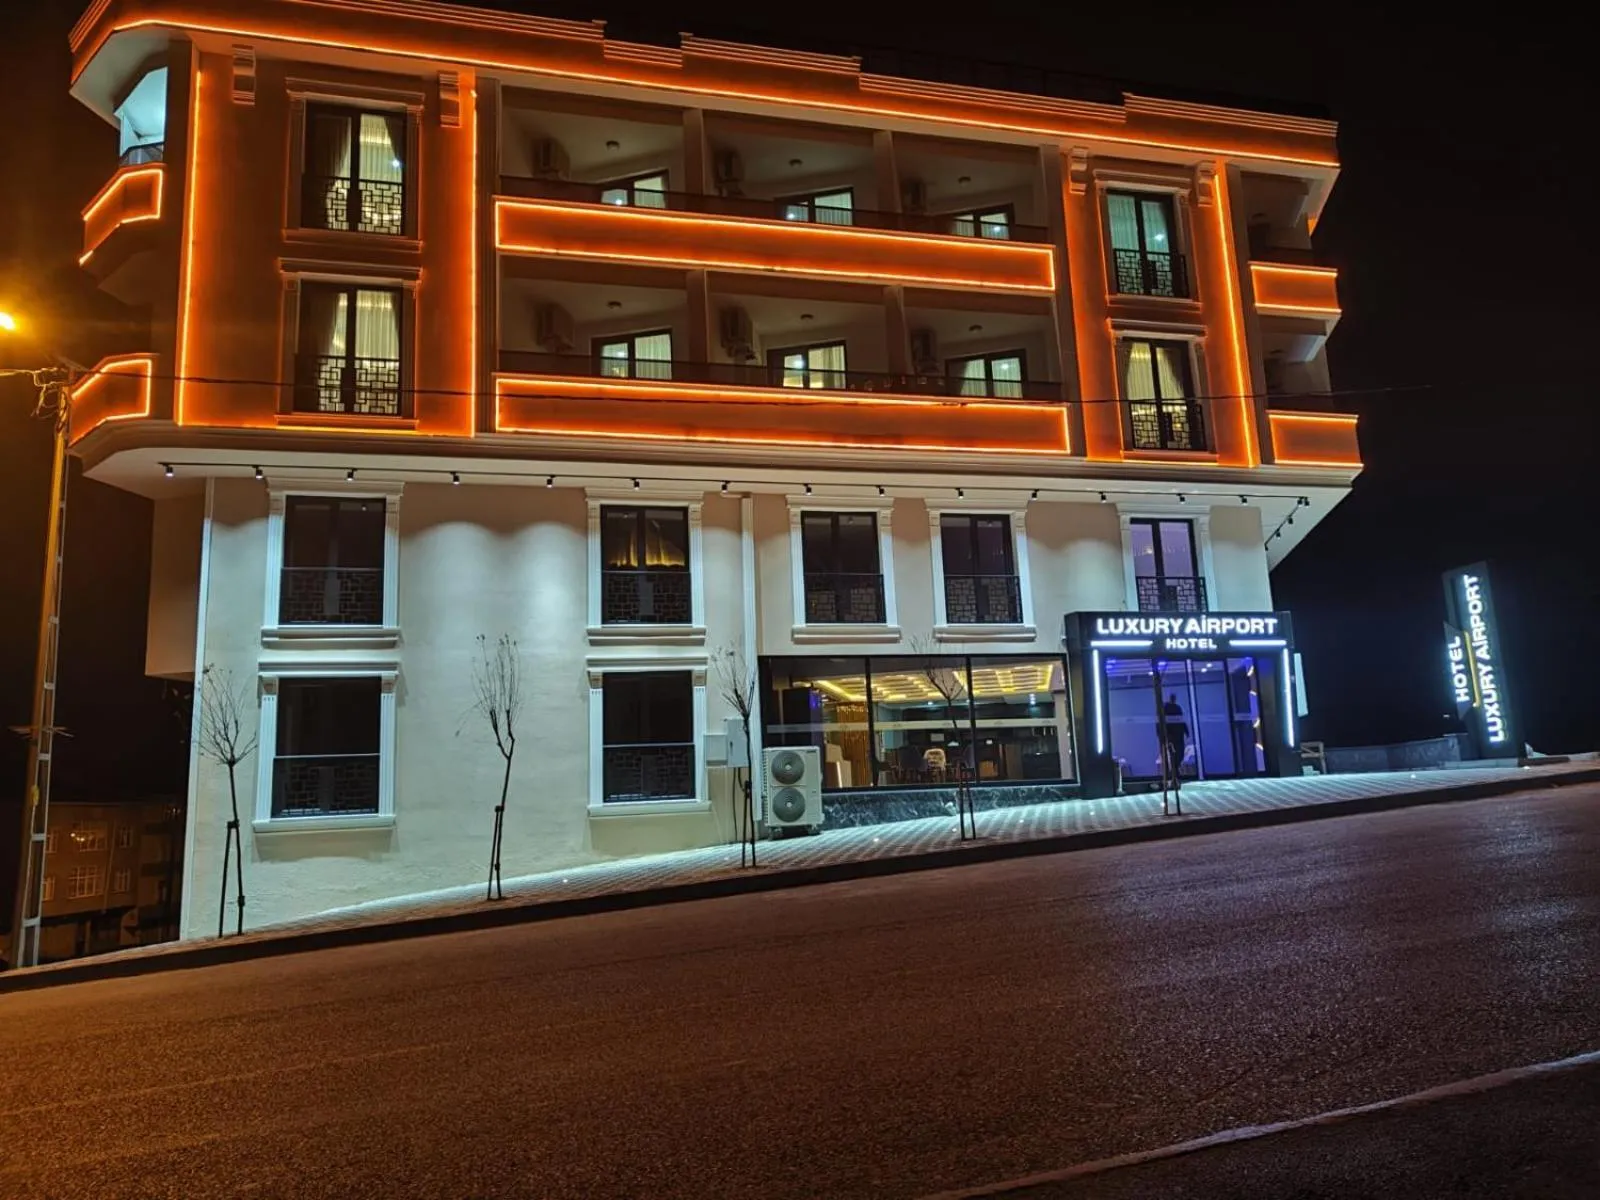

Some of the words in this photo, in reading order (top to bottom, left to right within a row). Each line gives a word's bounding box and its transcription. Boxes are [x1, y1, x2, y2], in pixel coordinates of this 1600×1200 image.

[1096, 618, 1184, 634] LUXURY
[1165, 638, 1217, 649] HOTEL
[1448, 635, 1470, 702] HOTEL
[1477, 663, 1505, 743] LUXURY
